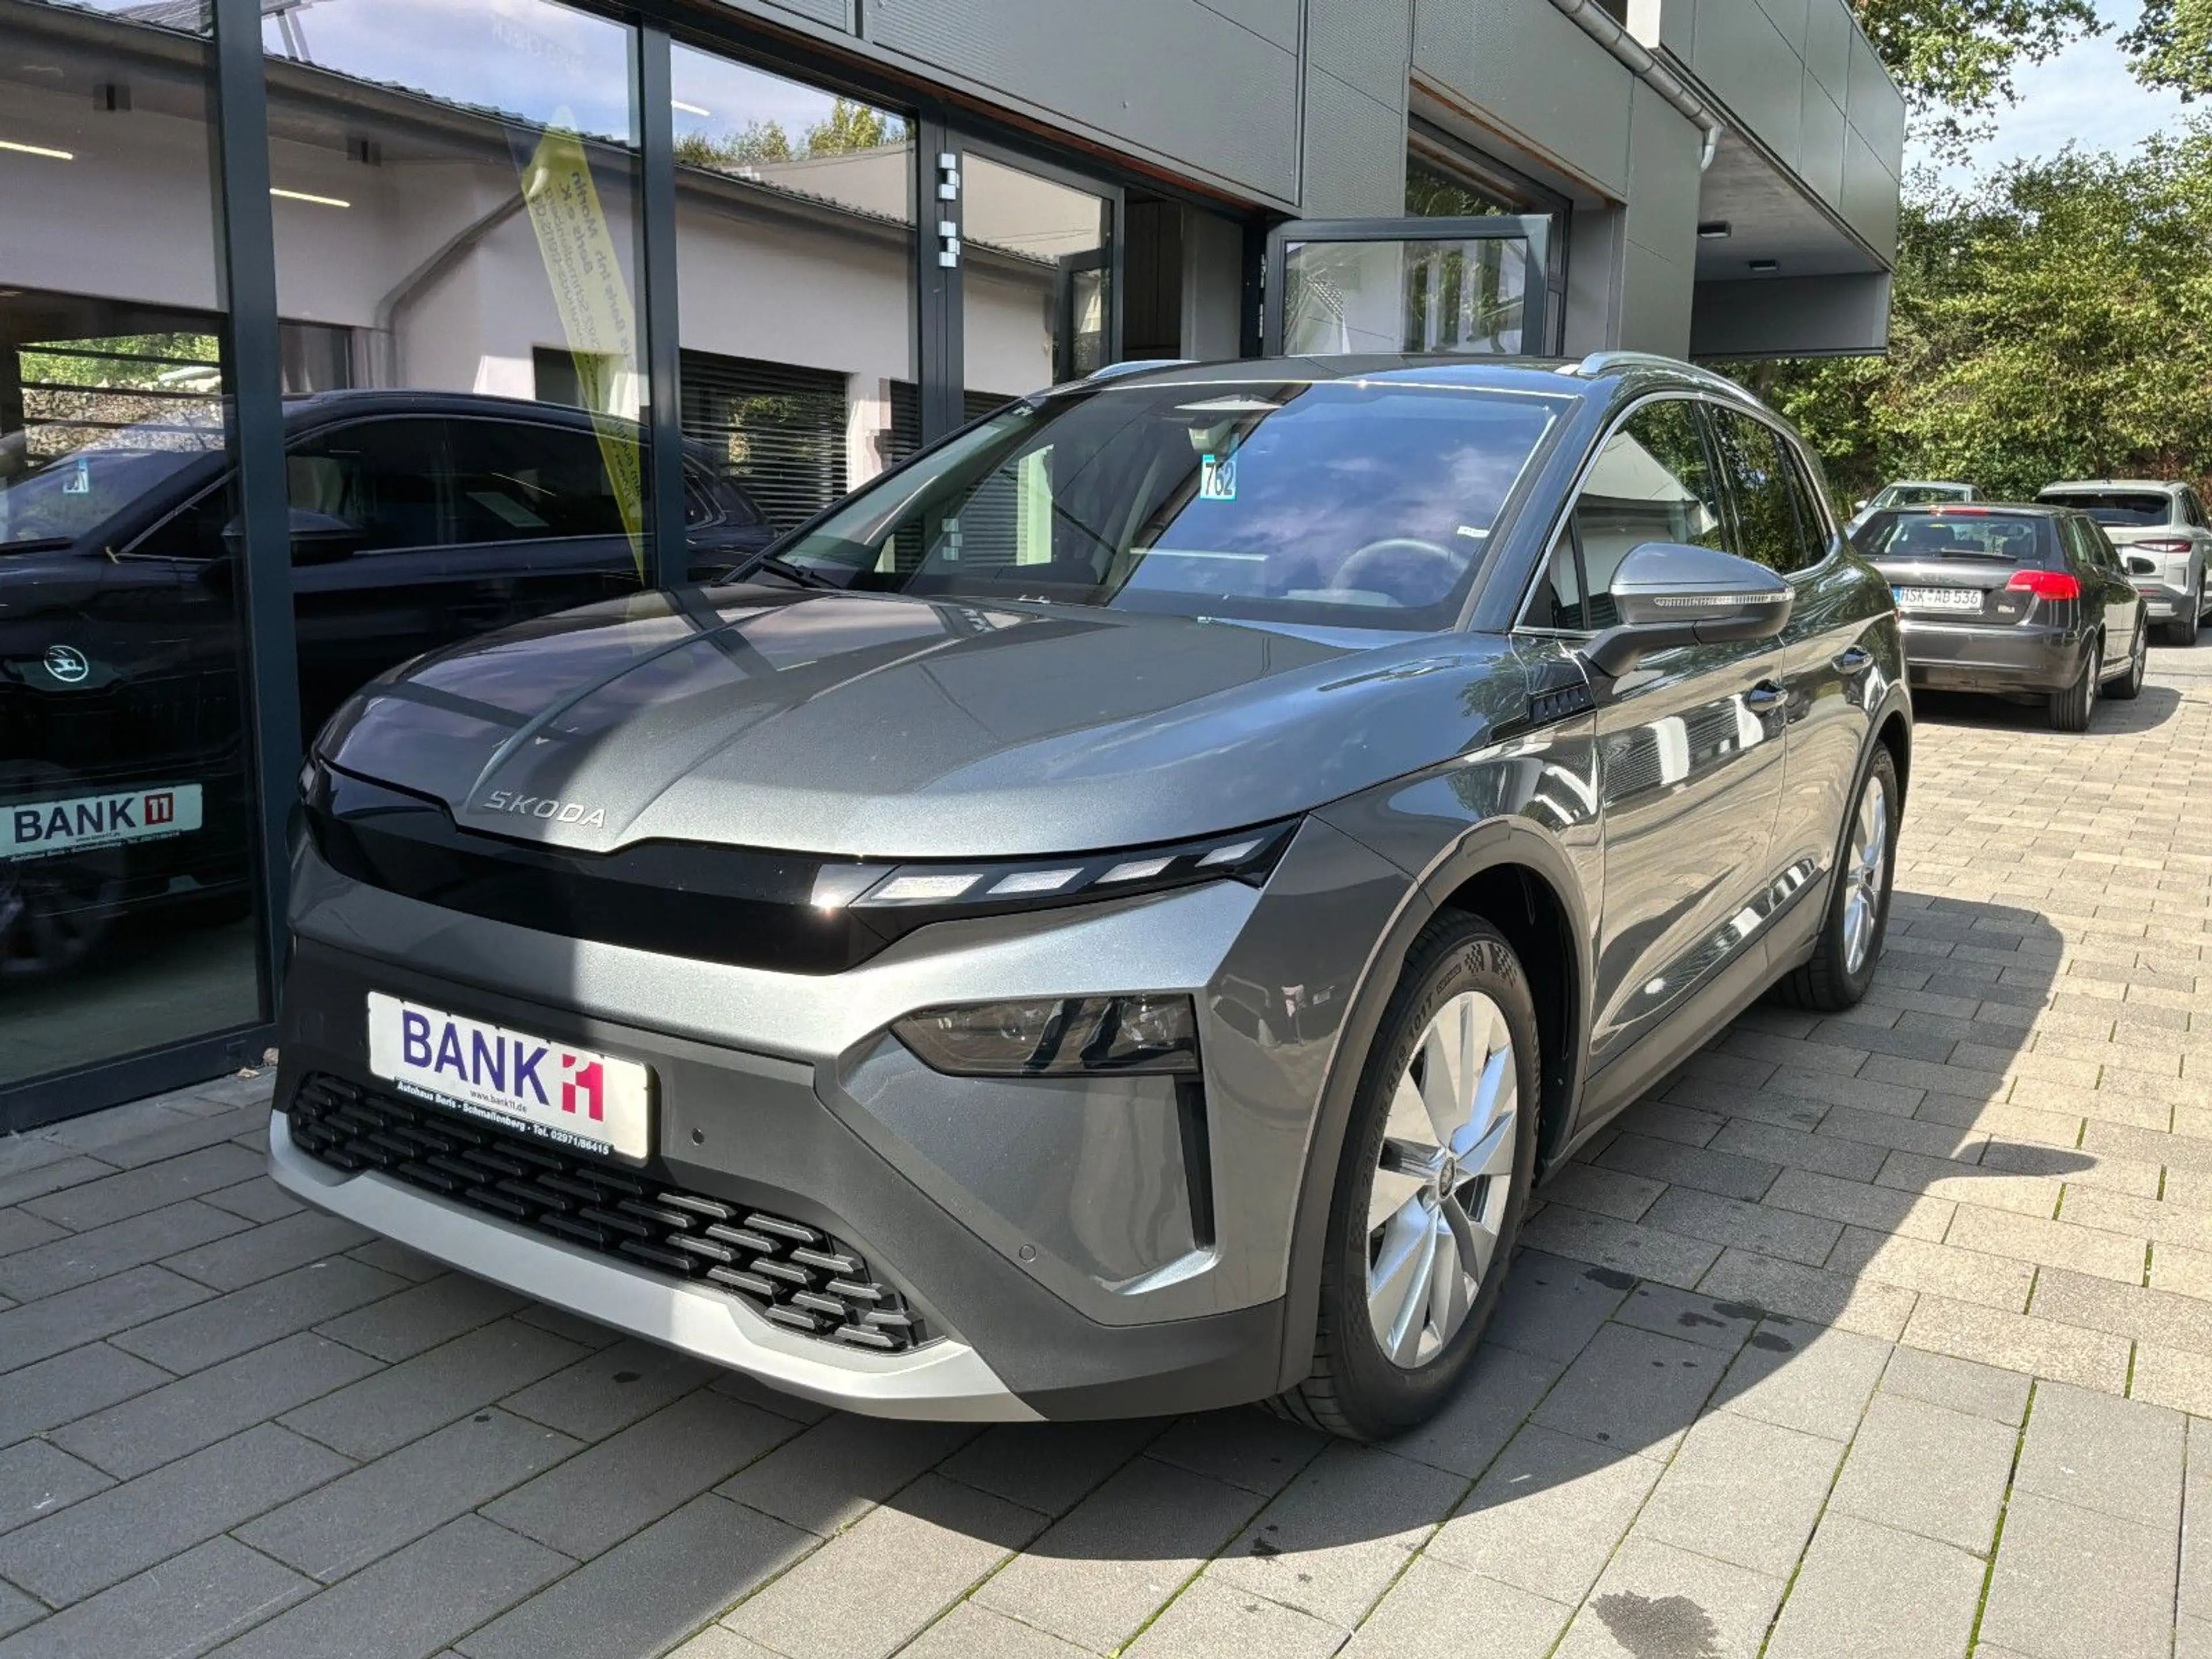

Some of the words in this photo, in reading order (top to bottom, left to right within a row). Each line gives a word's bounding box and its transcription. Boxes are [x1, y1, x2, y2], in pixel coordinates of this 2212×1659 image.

[1205, 461, 1234, 496] 762
[1953, 590, 1978, 604] 536
[13, 797, 137, 843] BANK
[403, 1009, 550, 1106] BANK
[397, 1080, 434, 1101] Autohaus
[463, 1103, 526, 1132] Schmallenberg
[532, 1124, 549, 1138] Tel.
[469, 1089, 528, 1113] www.bank11.de
